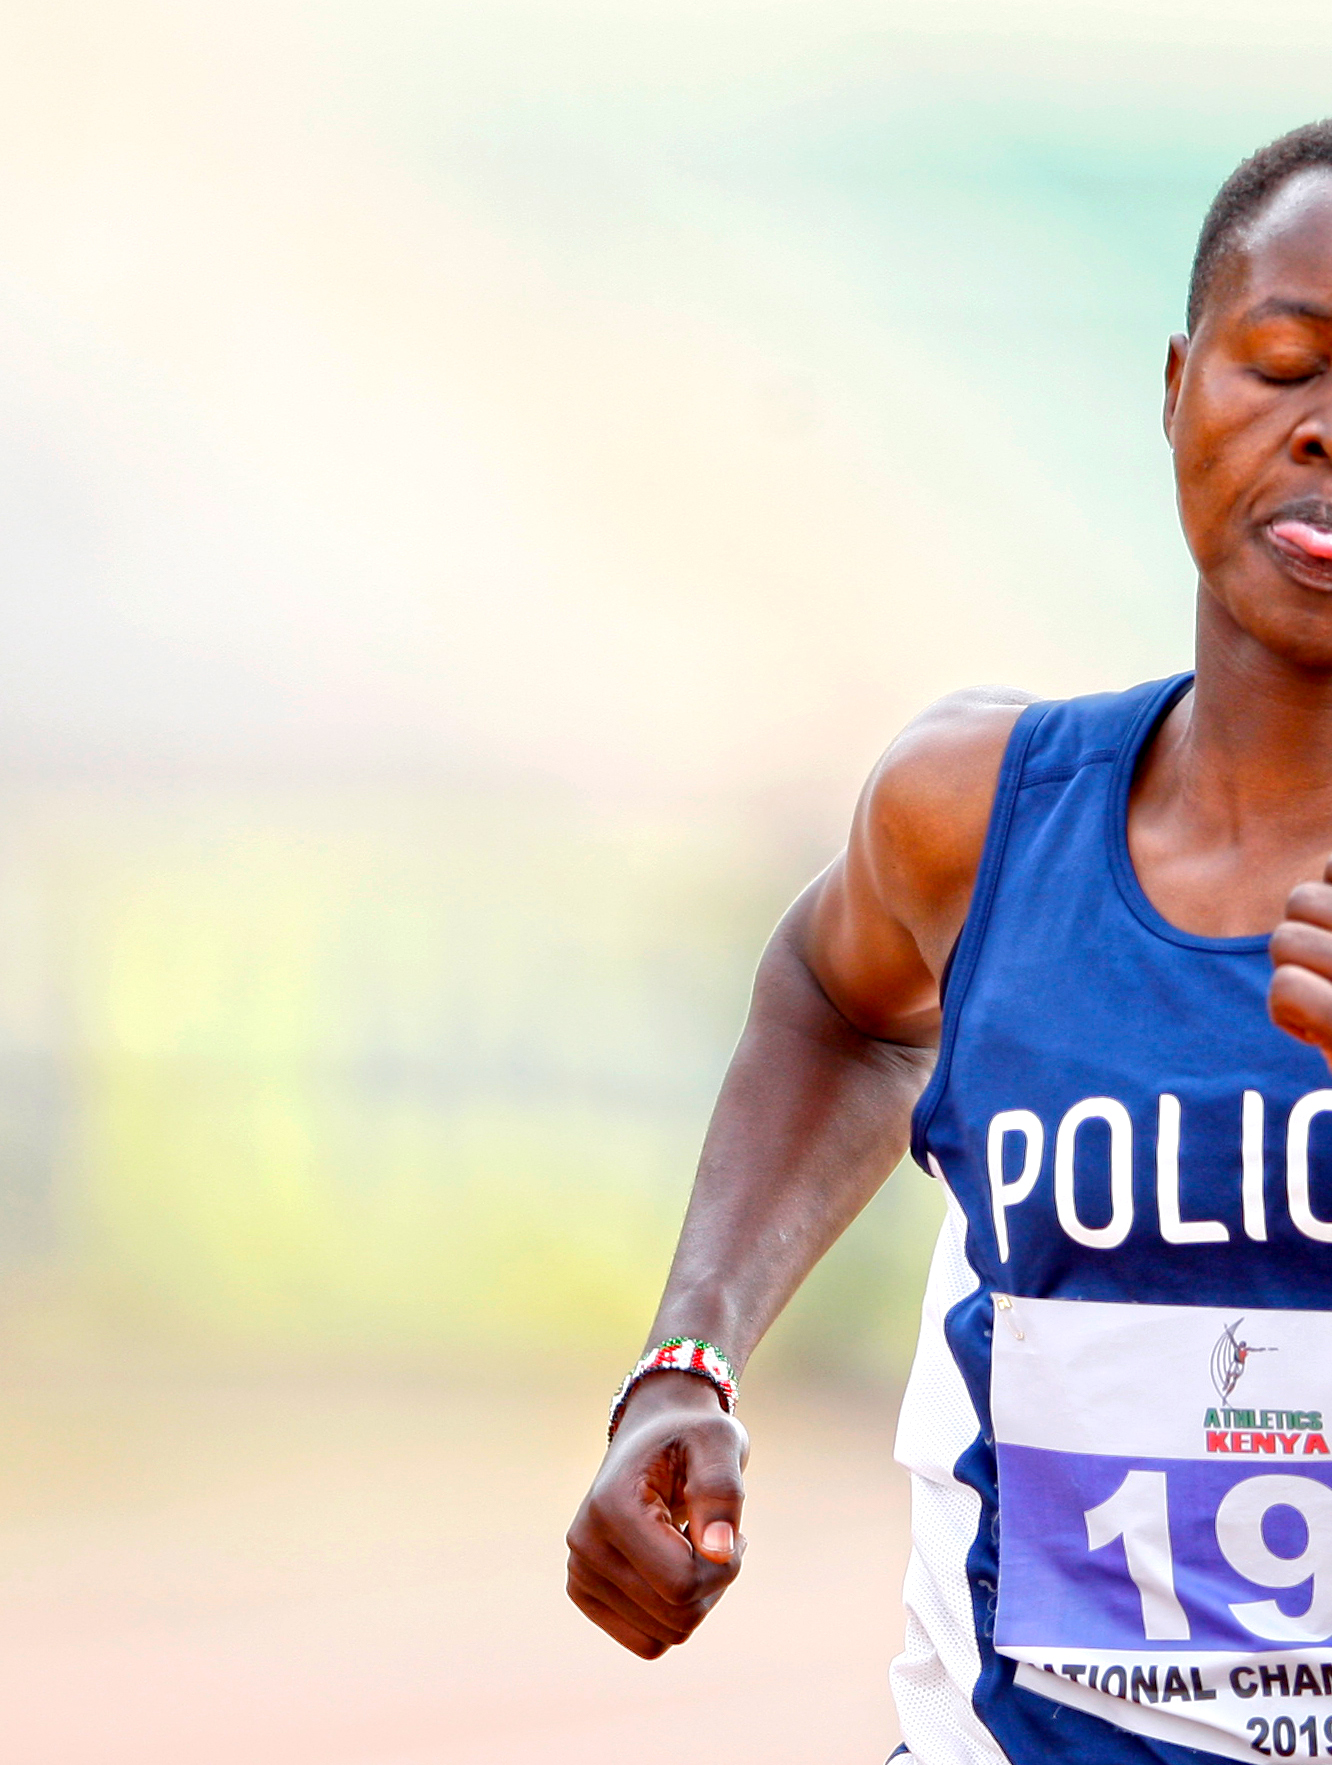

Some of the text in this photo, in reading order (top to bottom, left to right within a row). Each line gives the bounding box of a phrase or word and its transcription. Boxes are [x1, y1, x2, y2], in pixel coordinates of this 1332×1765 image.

[1203, 1407, 1323, 1430] ATHLETICS
[1206, 1430, 1330, 1454] KENYA
[1026, 1663, 1217, 1706] TIONAL
